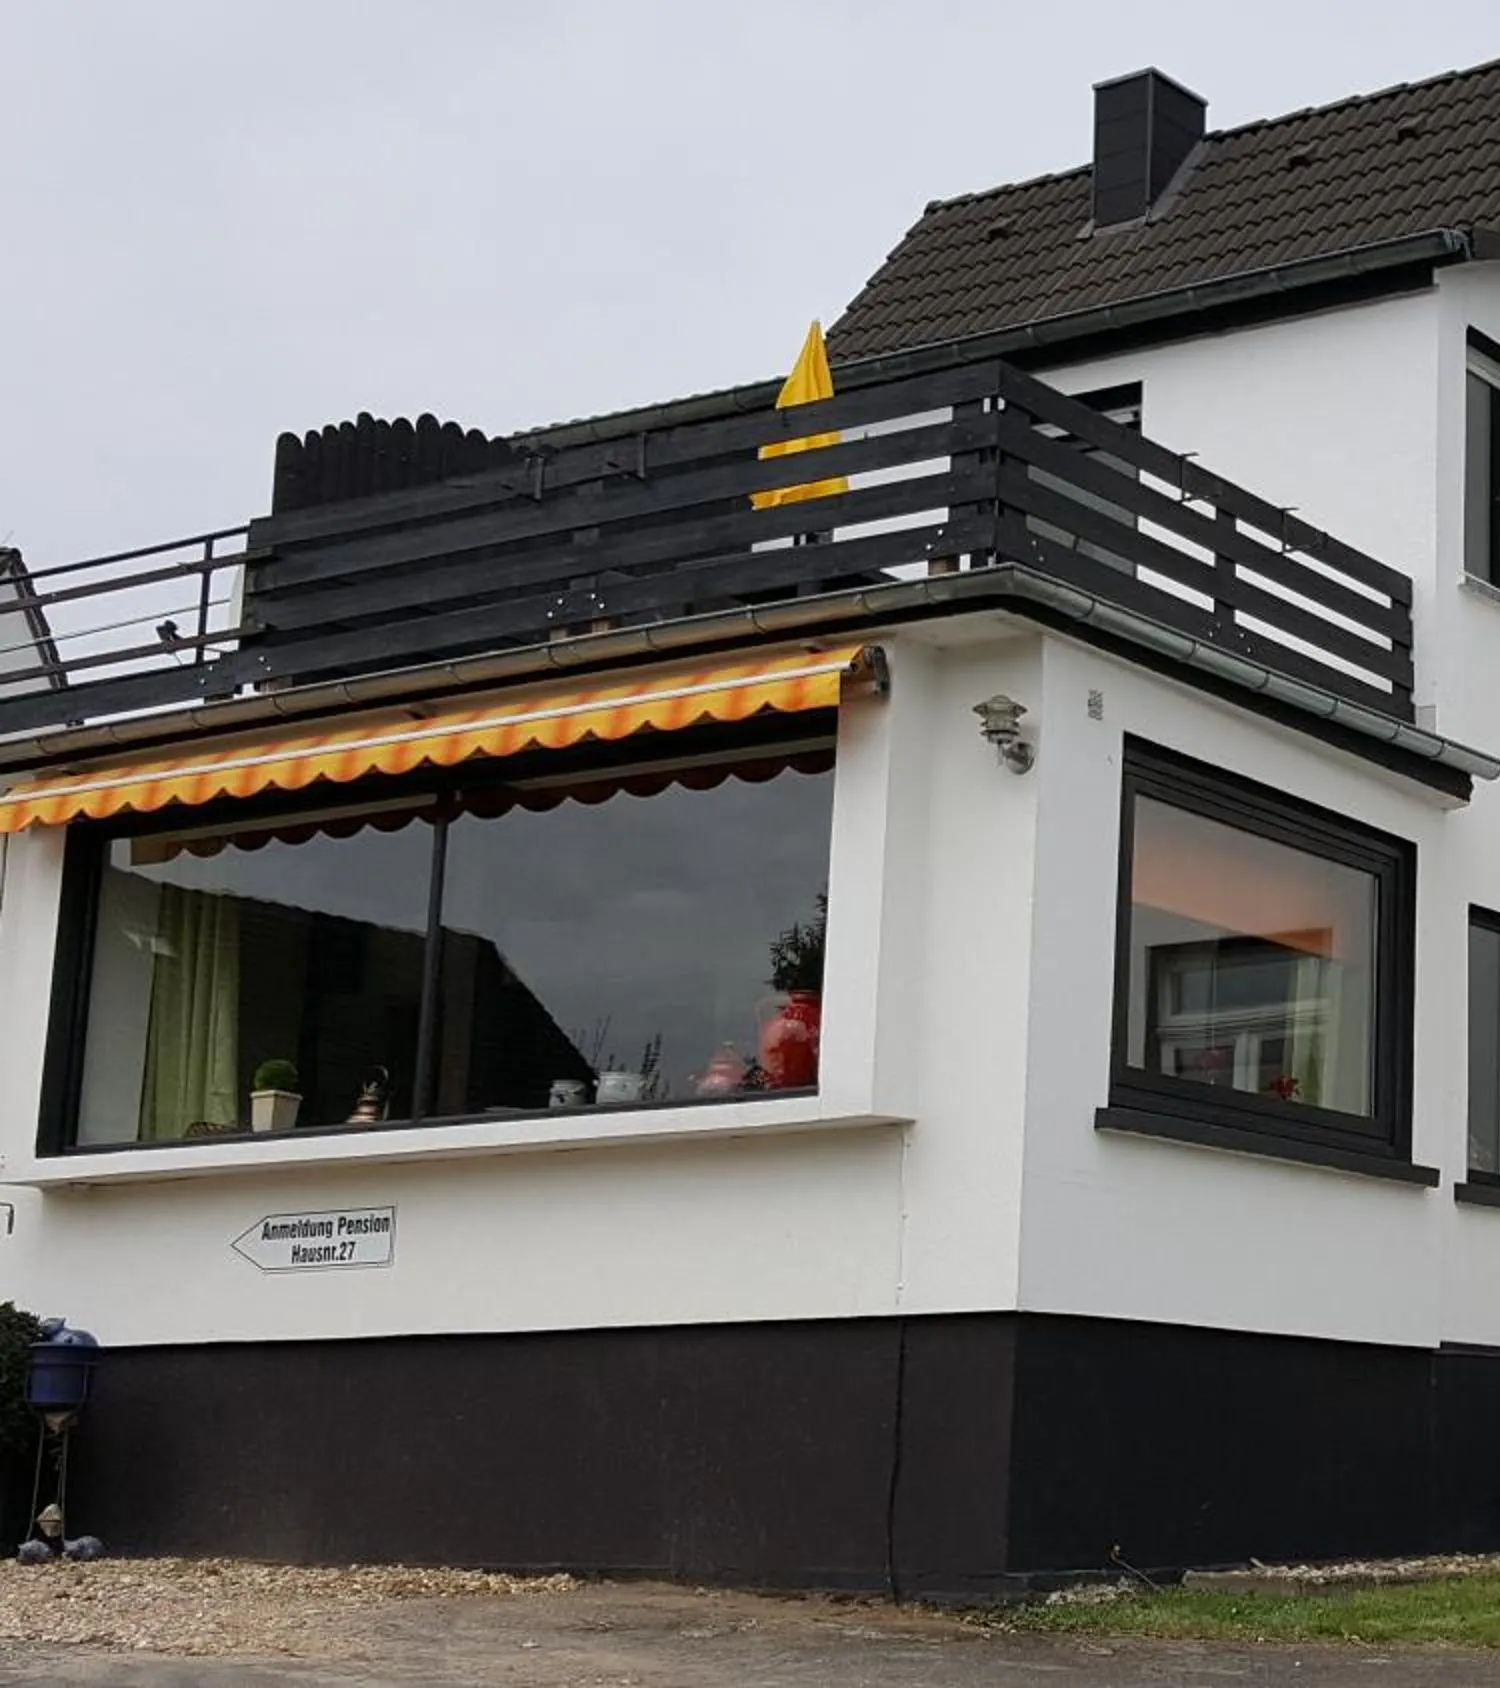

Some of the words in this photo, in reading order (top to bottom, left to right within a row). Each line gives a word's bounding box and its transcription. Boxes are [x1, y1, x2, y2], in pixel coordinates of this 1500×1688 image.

[261, 1218, 334, 1241] Anmeldung
[337, 1214, 390, 1236] Pension
[291, 1241, 356, 1264] Hausnr.27
